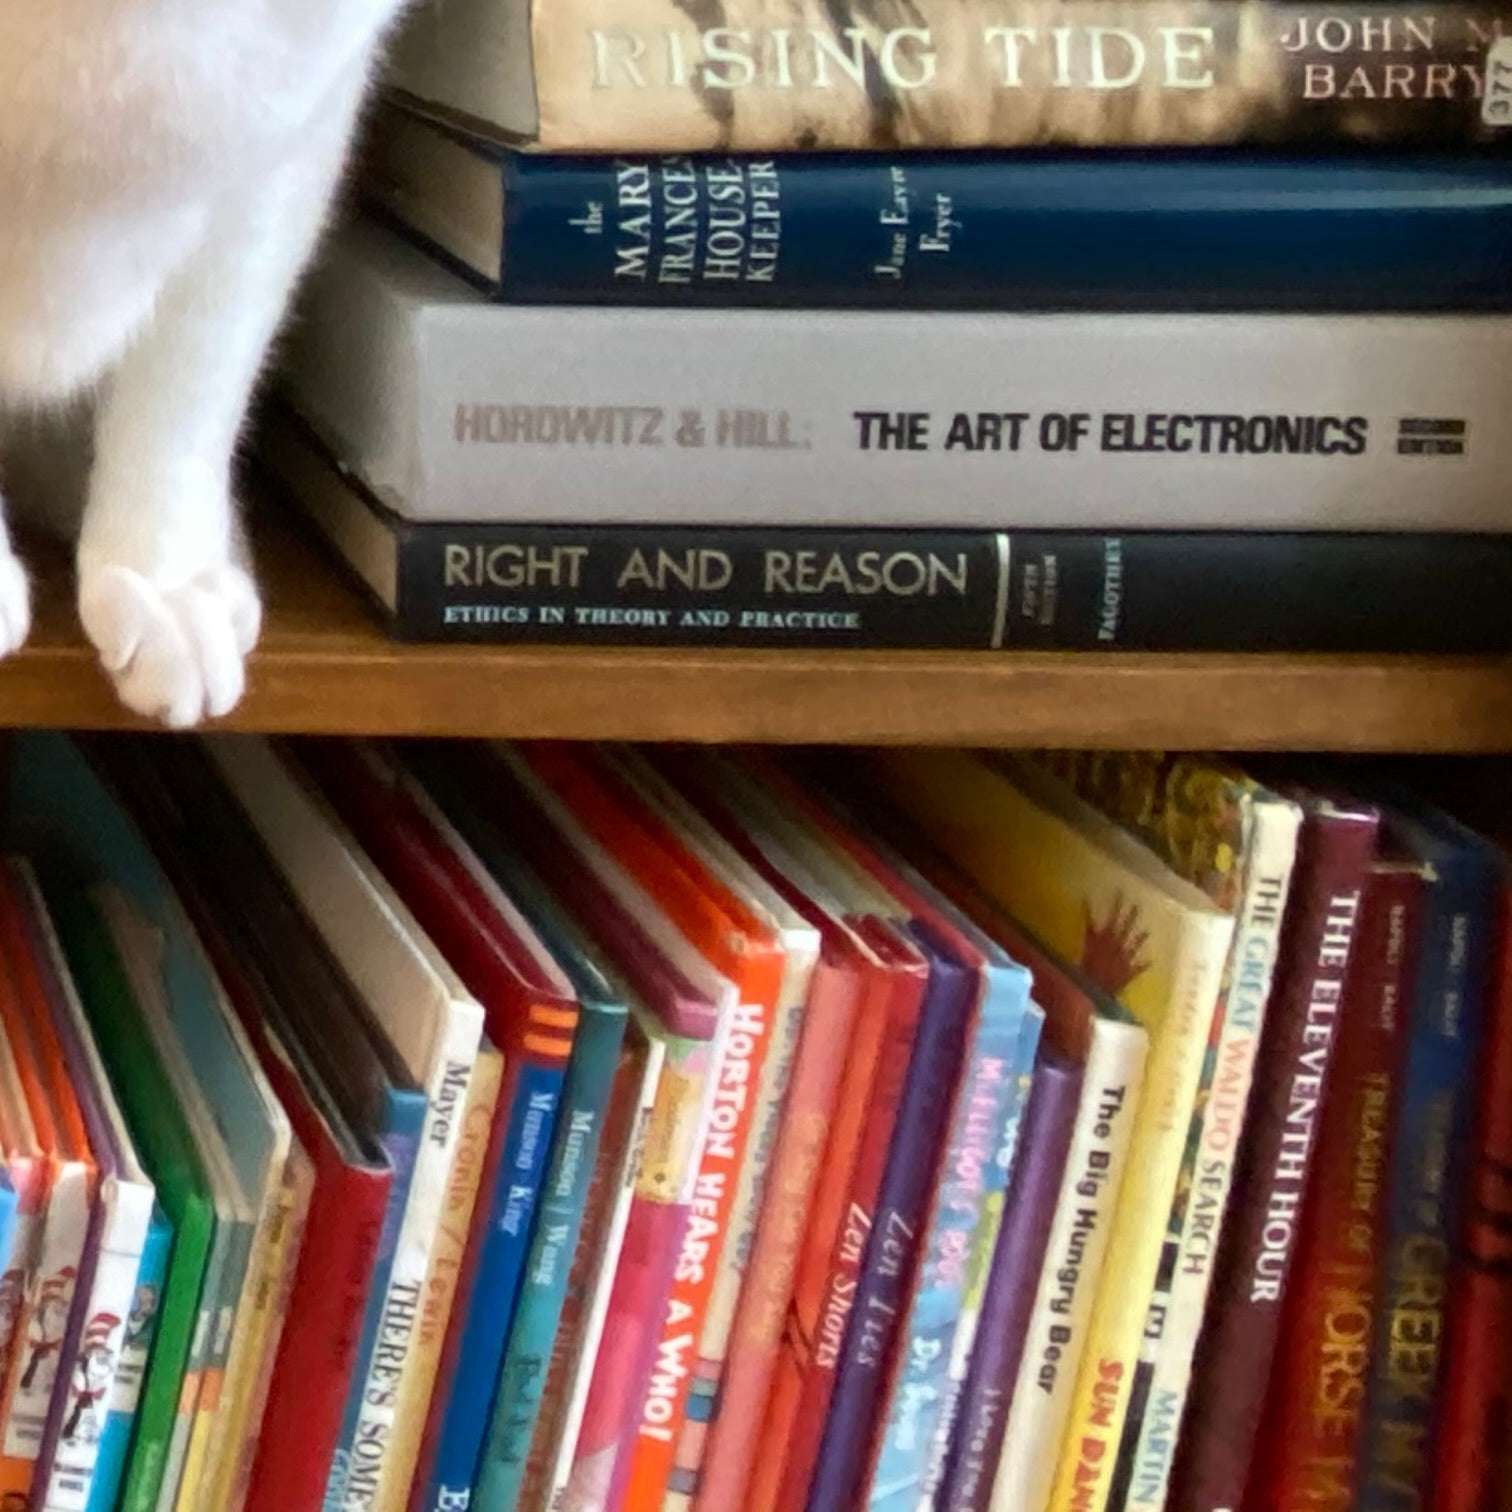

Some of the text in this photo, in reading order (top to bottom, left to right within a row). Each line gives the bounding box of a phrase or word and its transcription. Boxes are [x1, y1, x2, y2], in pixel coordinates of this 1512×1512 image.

[590, 25, 1216, 90] RISING TIDE
[1279, 14, 1437, 54] JOHN
[568, 199, 605, 235] the
[613, 159, 652, 281] MARY
[745, 159, 781, 284] KEEPER
[453, 402, 1369, 456] HOROWITZ & THE ART OF ELECTRONICS
[442, 604, 862, 631] ETHICS IN THEORY AND PRACTICE
[443, 543, 968, 597] RIGHT AND REASON
[1096, 537, 1123, 642] FAGOTHEY
[1251, 875, 1284, 931] THE
[1232, 935, 1272, 1034] GREAT
[428, 1061, 473, 1149] Mayer
[1203, 1036, 1254, 1153] WALDO
[1248, 890, 1361, 1306] THE ELEVENTH HOUR
[497, 1183, 533, 1238] King
[533, 1110, 594, 1287] Munson Wang
[638, 1003, 765, 1443] HORTON HEARS A WHO!
[1038, 1084, 1126, 1396] The Big Hungry Bear
[1180, 1157, 1227, 1276] SEARCH
[364, 1279, 423, 1414] THERE'S
[1088, 1358, 1125, 1428] SUN
[1131, 1388, 1180, 1506] MARTIN
